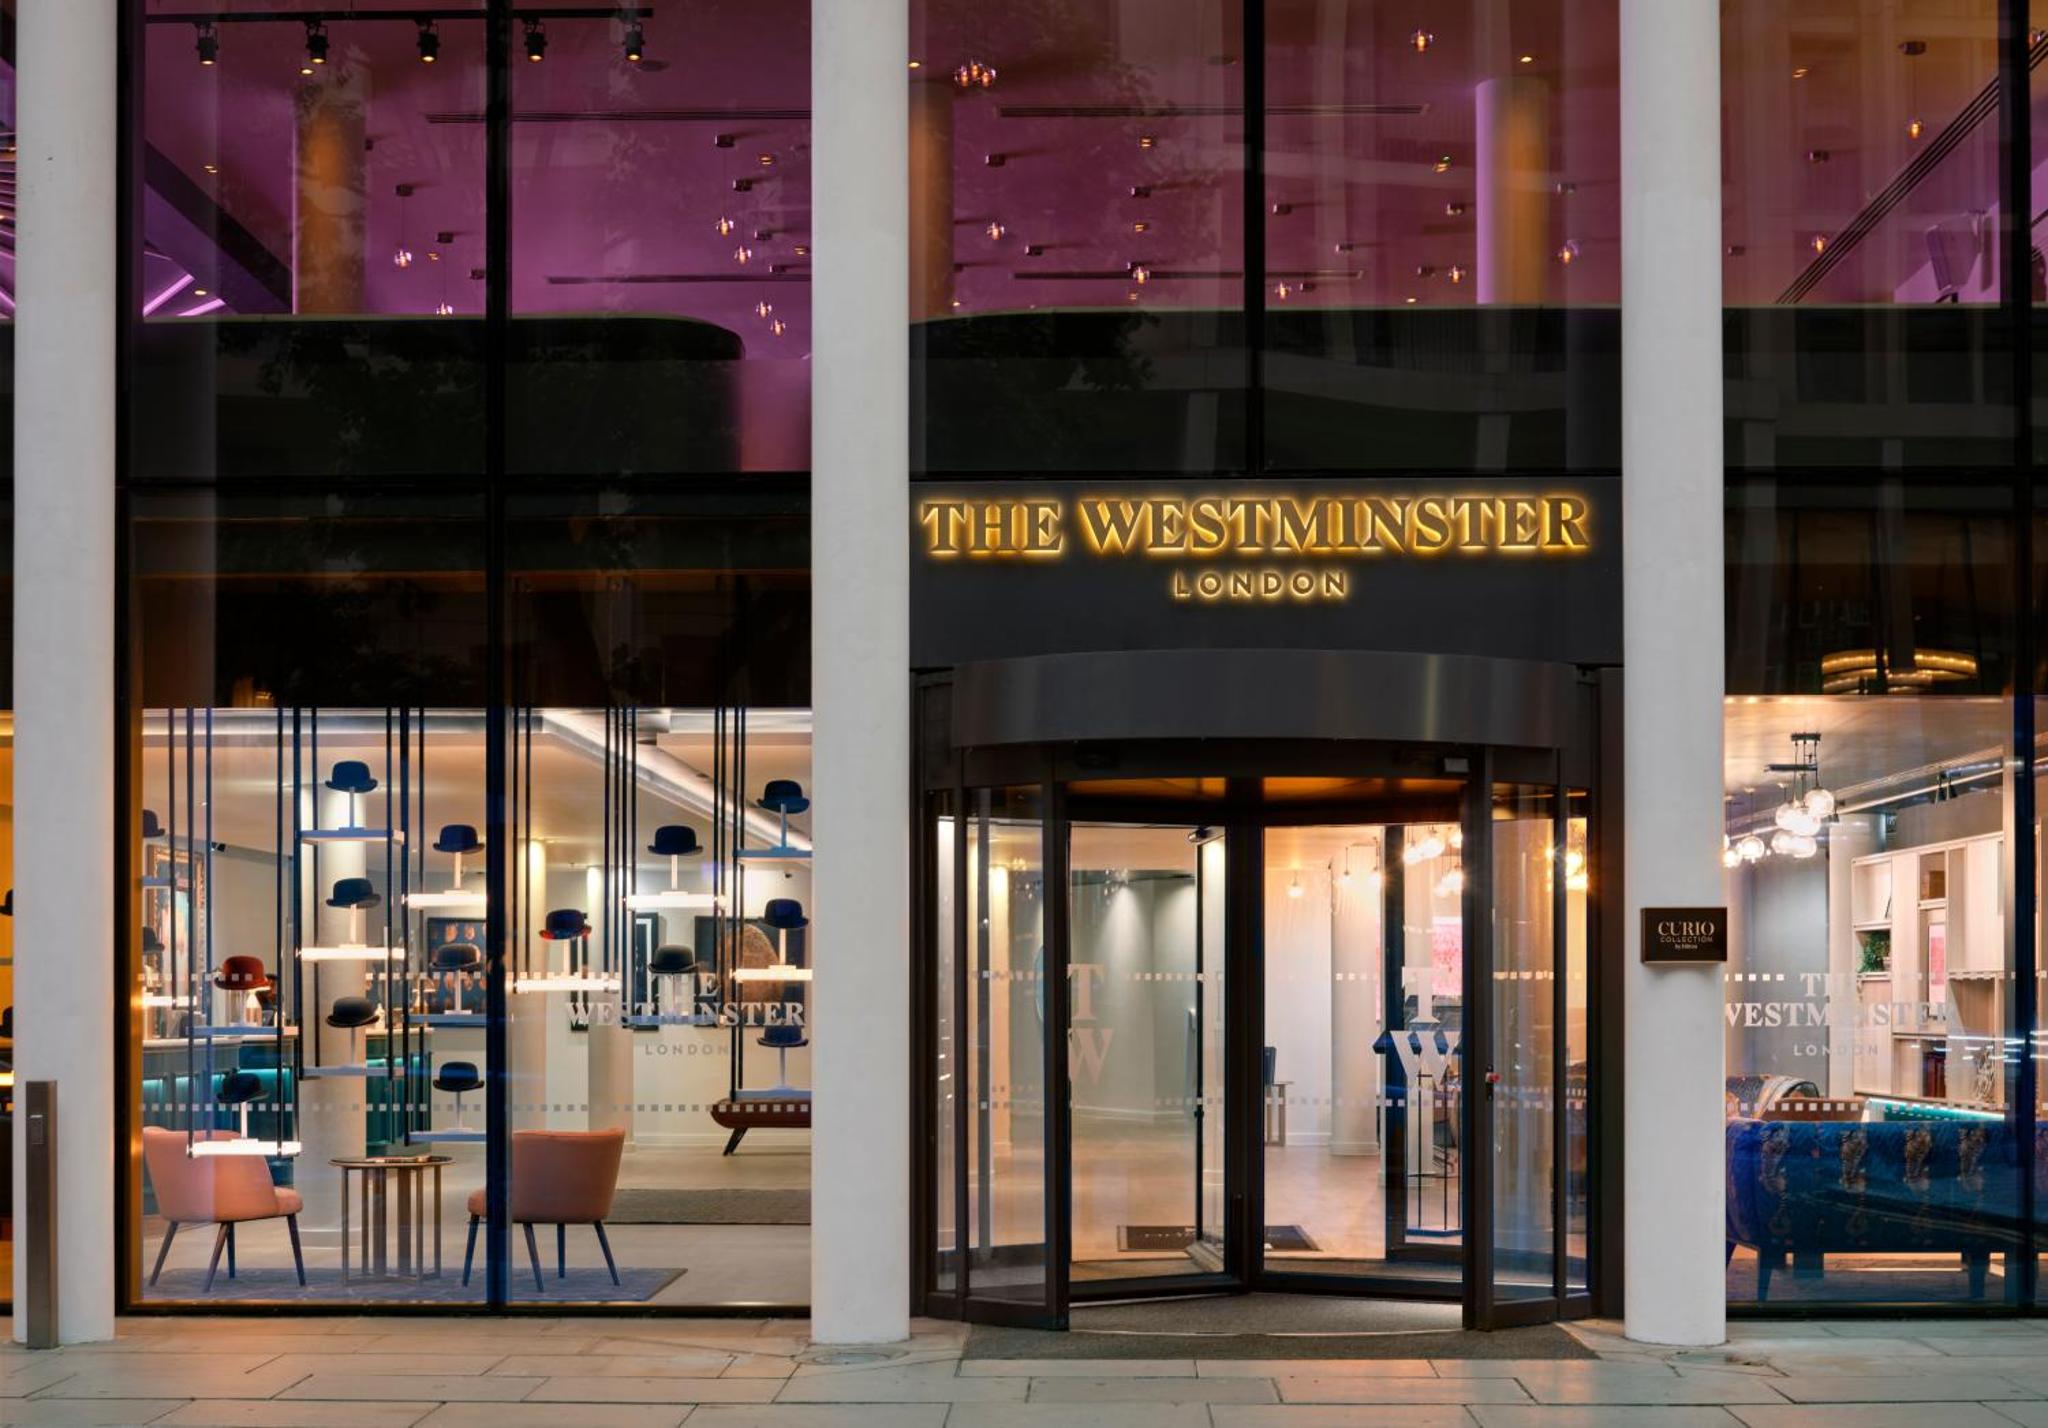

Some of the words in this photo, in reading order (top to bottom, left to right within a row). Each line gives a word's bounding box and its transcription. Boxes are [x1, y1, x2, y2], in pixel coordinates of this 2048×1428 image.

[921, 502, 1062, 553] THE
[1079, 498, 1588, 554] WESTMINSTER
[1173, 571, 1347, 597] LONDON
[1657, 921, 1715, 936] CURIO
[645, 1044, 729, 1056] LONDON
[1390, 1030, 1462, 1088] W
